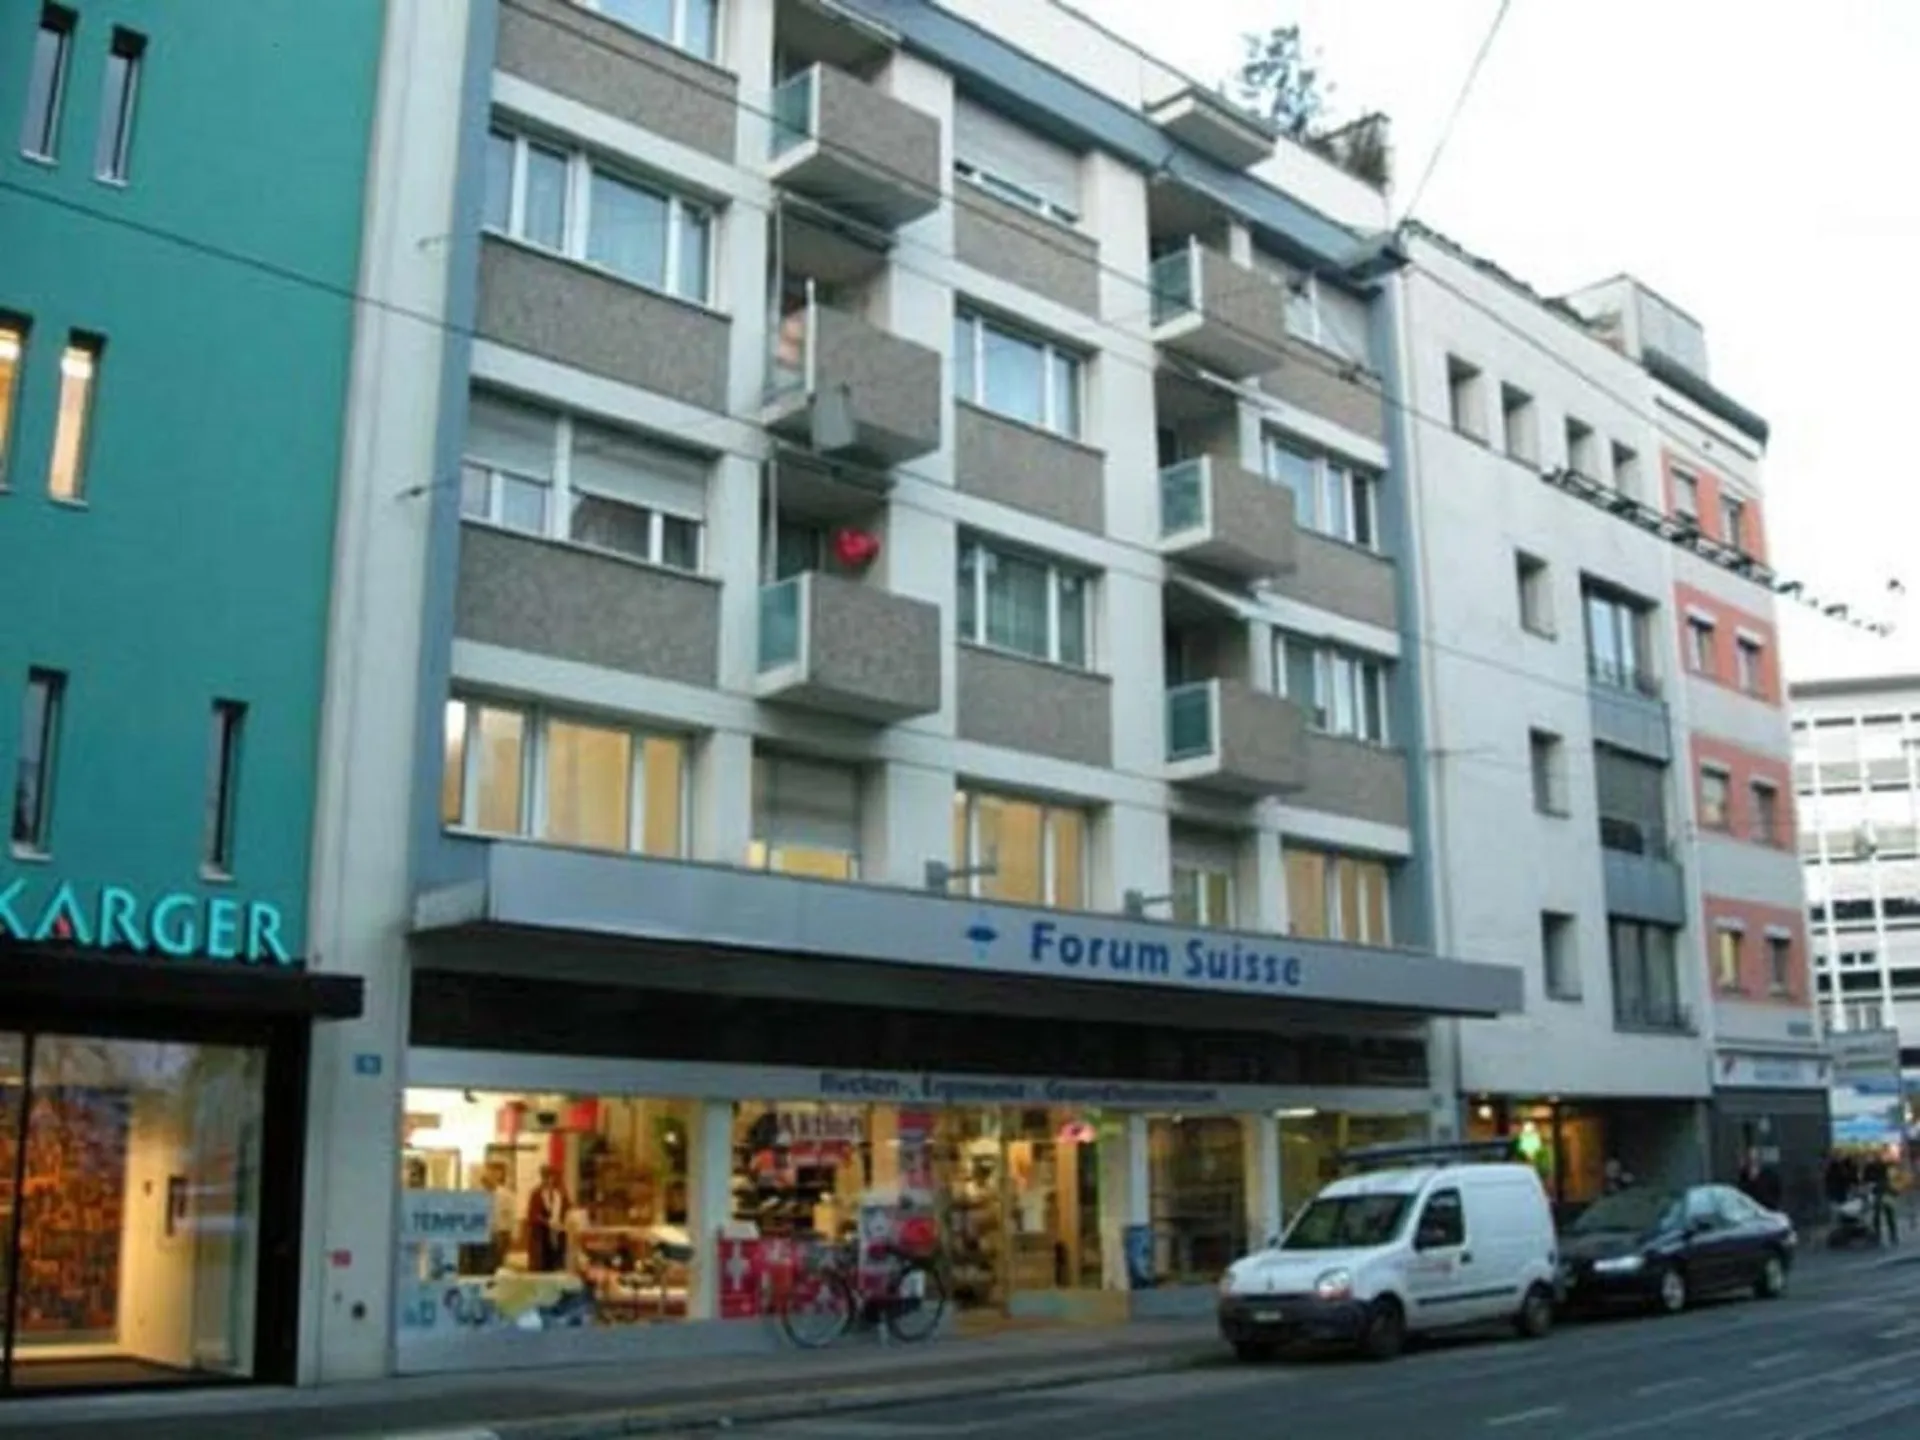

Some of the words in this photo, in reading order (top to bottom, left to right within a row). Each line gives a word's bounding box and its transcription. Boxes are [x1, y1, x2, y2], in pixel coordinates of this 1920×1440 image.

[0, 877, 292, 965] KARGER
[1030, 921, 1170, 974] Forum
[1184, 939, 1303, 987] Suisse
